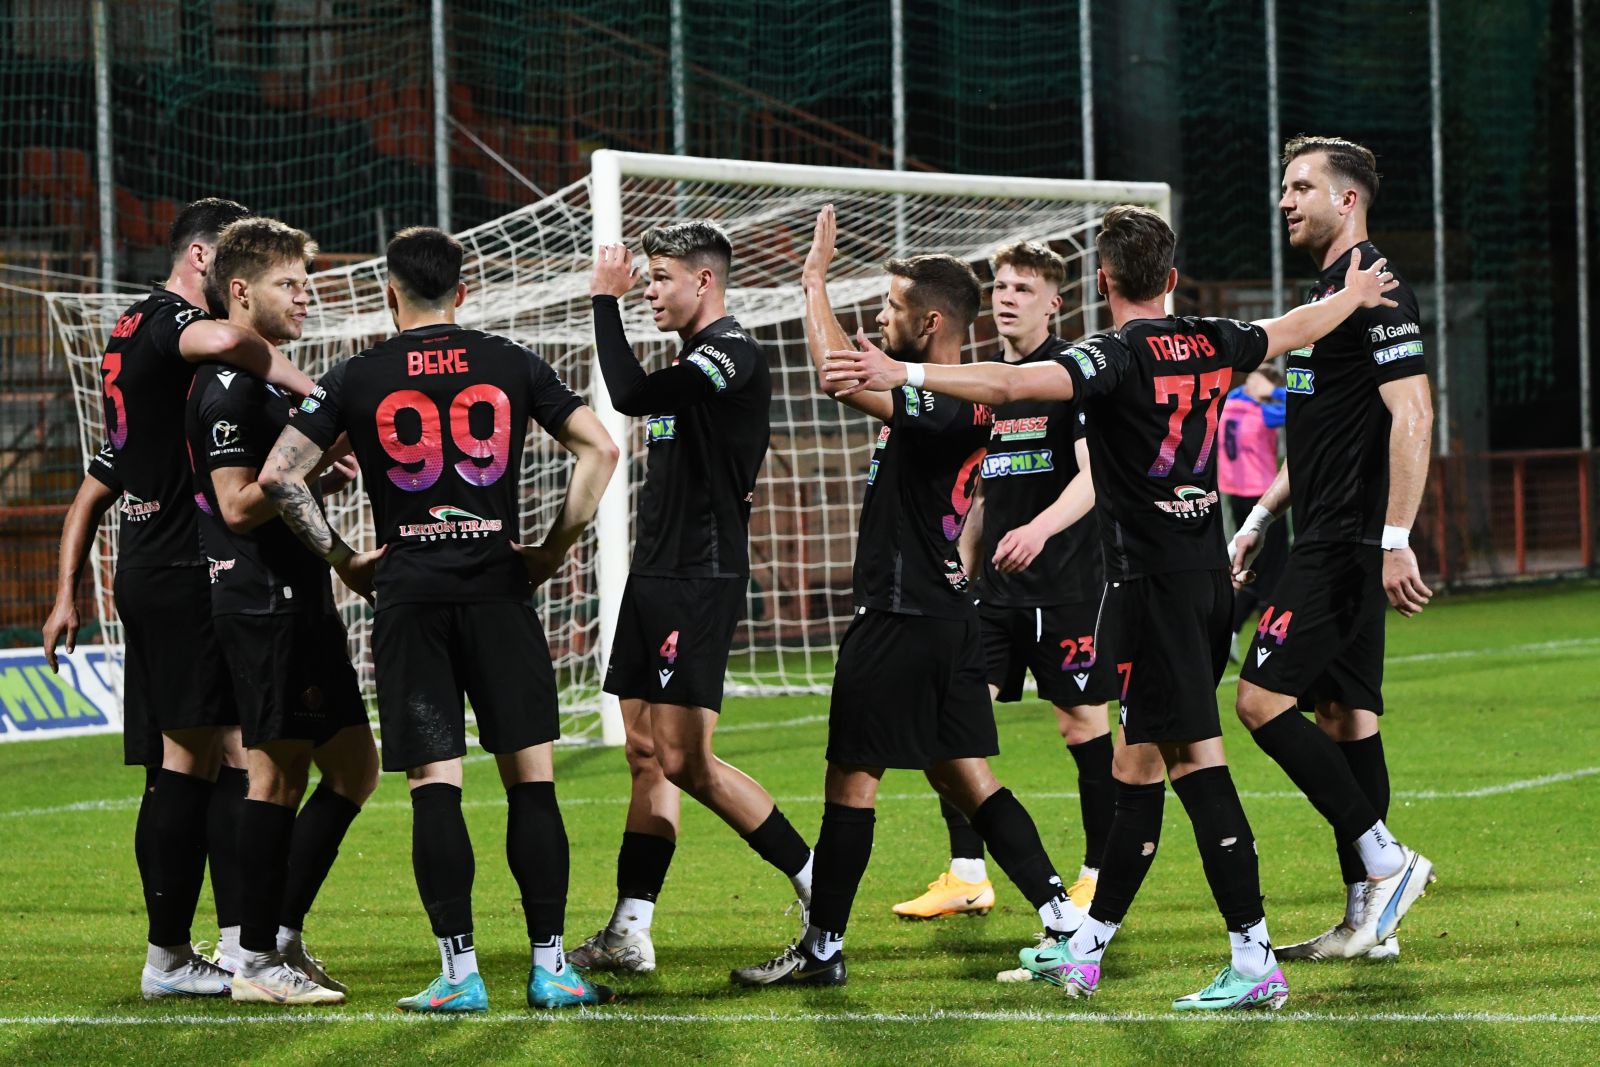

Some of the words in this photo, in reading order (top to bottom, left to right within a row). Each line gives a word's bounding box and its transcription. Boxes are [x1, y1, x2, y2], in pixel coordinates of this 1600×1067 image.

[407, 348, 469, 376] BEKE
[703, 345, 736, 378] GalWin
[376, 383, 511, 492] 99
[1147, 366, 1233, 478] 77
[981, 450, 1053, 478] iPPMIX
[1257, 605, 1293, 645] 44
[659, 630, 680, 665] 4
[1059, 636, 1096, 671] 23
